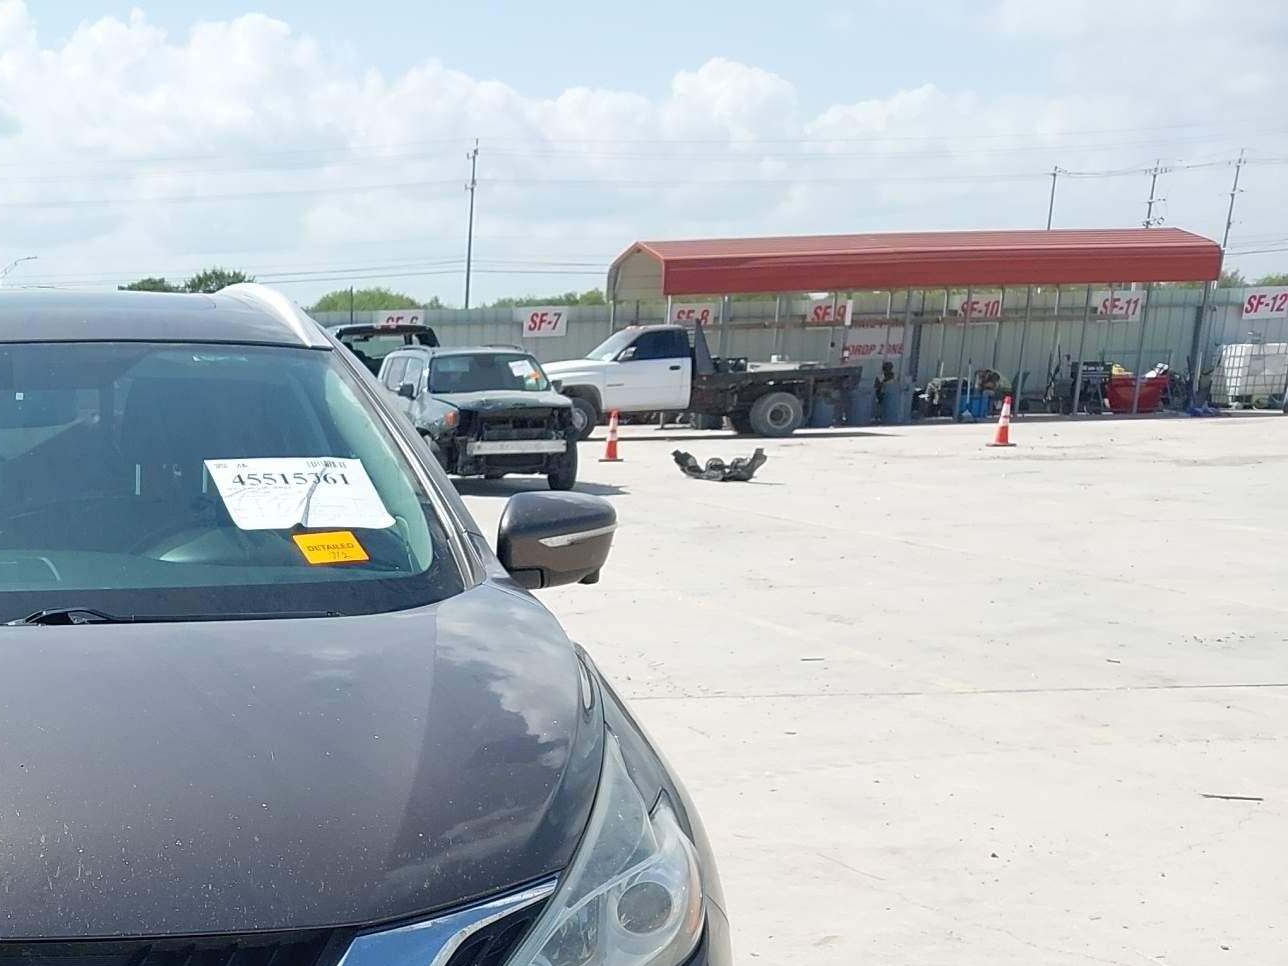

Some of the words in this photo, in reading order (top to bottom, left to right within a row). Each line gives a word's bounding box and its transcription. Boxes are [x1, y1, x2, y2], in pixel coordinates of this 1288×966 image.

[959, 300, 1001, 319] SF-10
[1098, 298, 1140, 317] SF-11
[1245, 293, 1288, 314] SF-12
[528, 312, 562, 331] SF-7
[677, 309, 710, 327] SF8
[812, 304, 847, 322] SF9
[232, 472, 350, 486] 45515361
[307, 543, 354, 552] DETAILED
